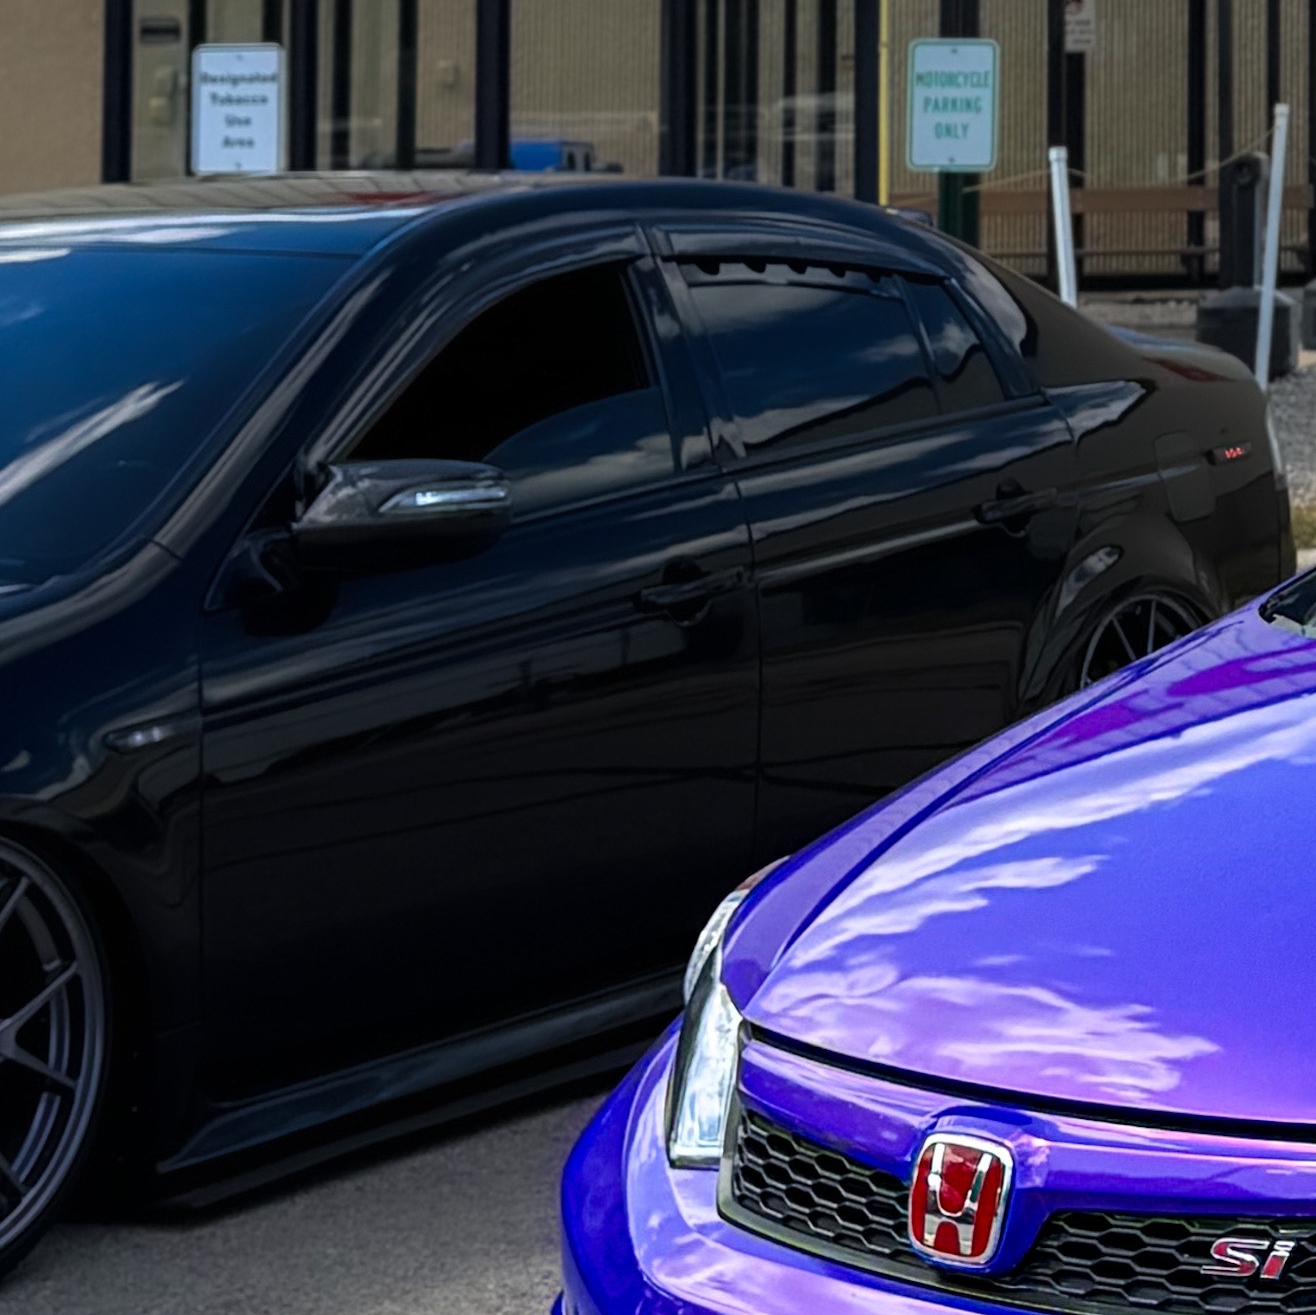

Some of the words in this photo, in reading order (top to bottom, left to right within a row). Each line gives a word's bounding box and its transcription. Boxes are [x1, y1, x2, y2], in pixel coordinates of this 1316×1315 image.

[915, 71, 990, 89] MOTORCYCLE
[209, 92, 269, 106] Tobacco
[923, 97, 983, 114] PARKING
[225, 114, 252, 127] Use
[934, 123, 969, 139] ONLY
[222, 136, 255, 149] Area
[1200, 1237, 1298, 1280] Si
